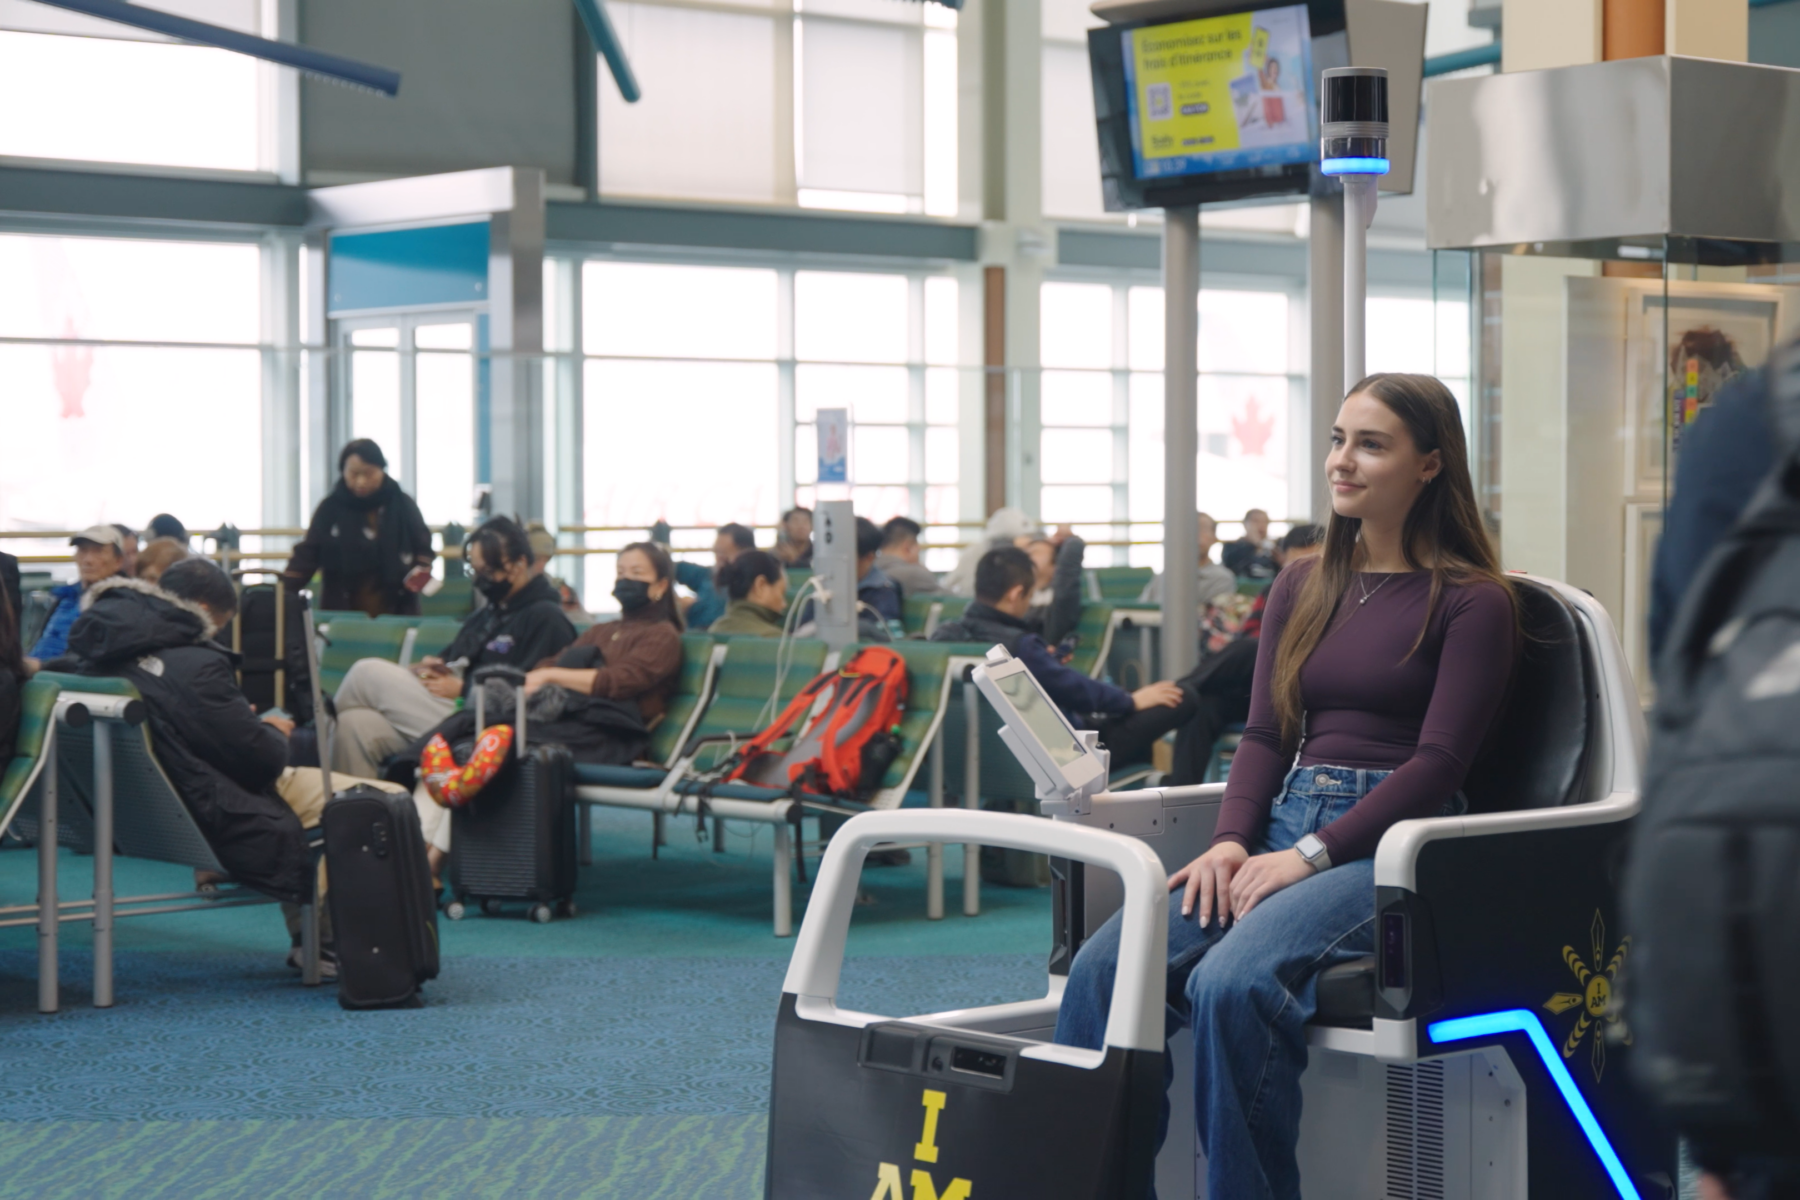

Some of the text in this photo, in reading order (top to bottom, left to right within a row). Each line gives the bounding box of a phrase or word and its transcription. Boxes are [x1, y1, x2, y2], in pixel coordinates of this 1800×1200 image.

[1597, 982, 1601, 994] I
[1590, 995, 1606, 1008] AM
[914, 1088, 947, 1163] I
